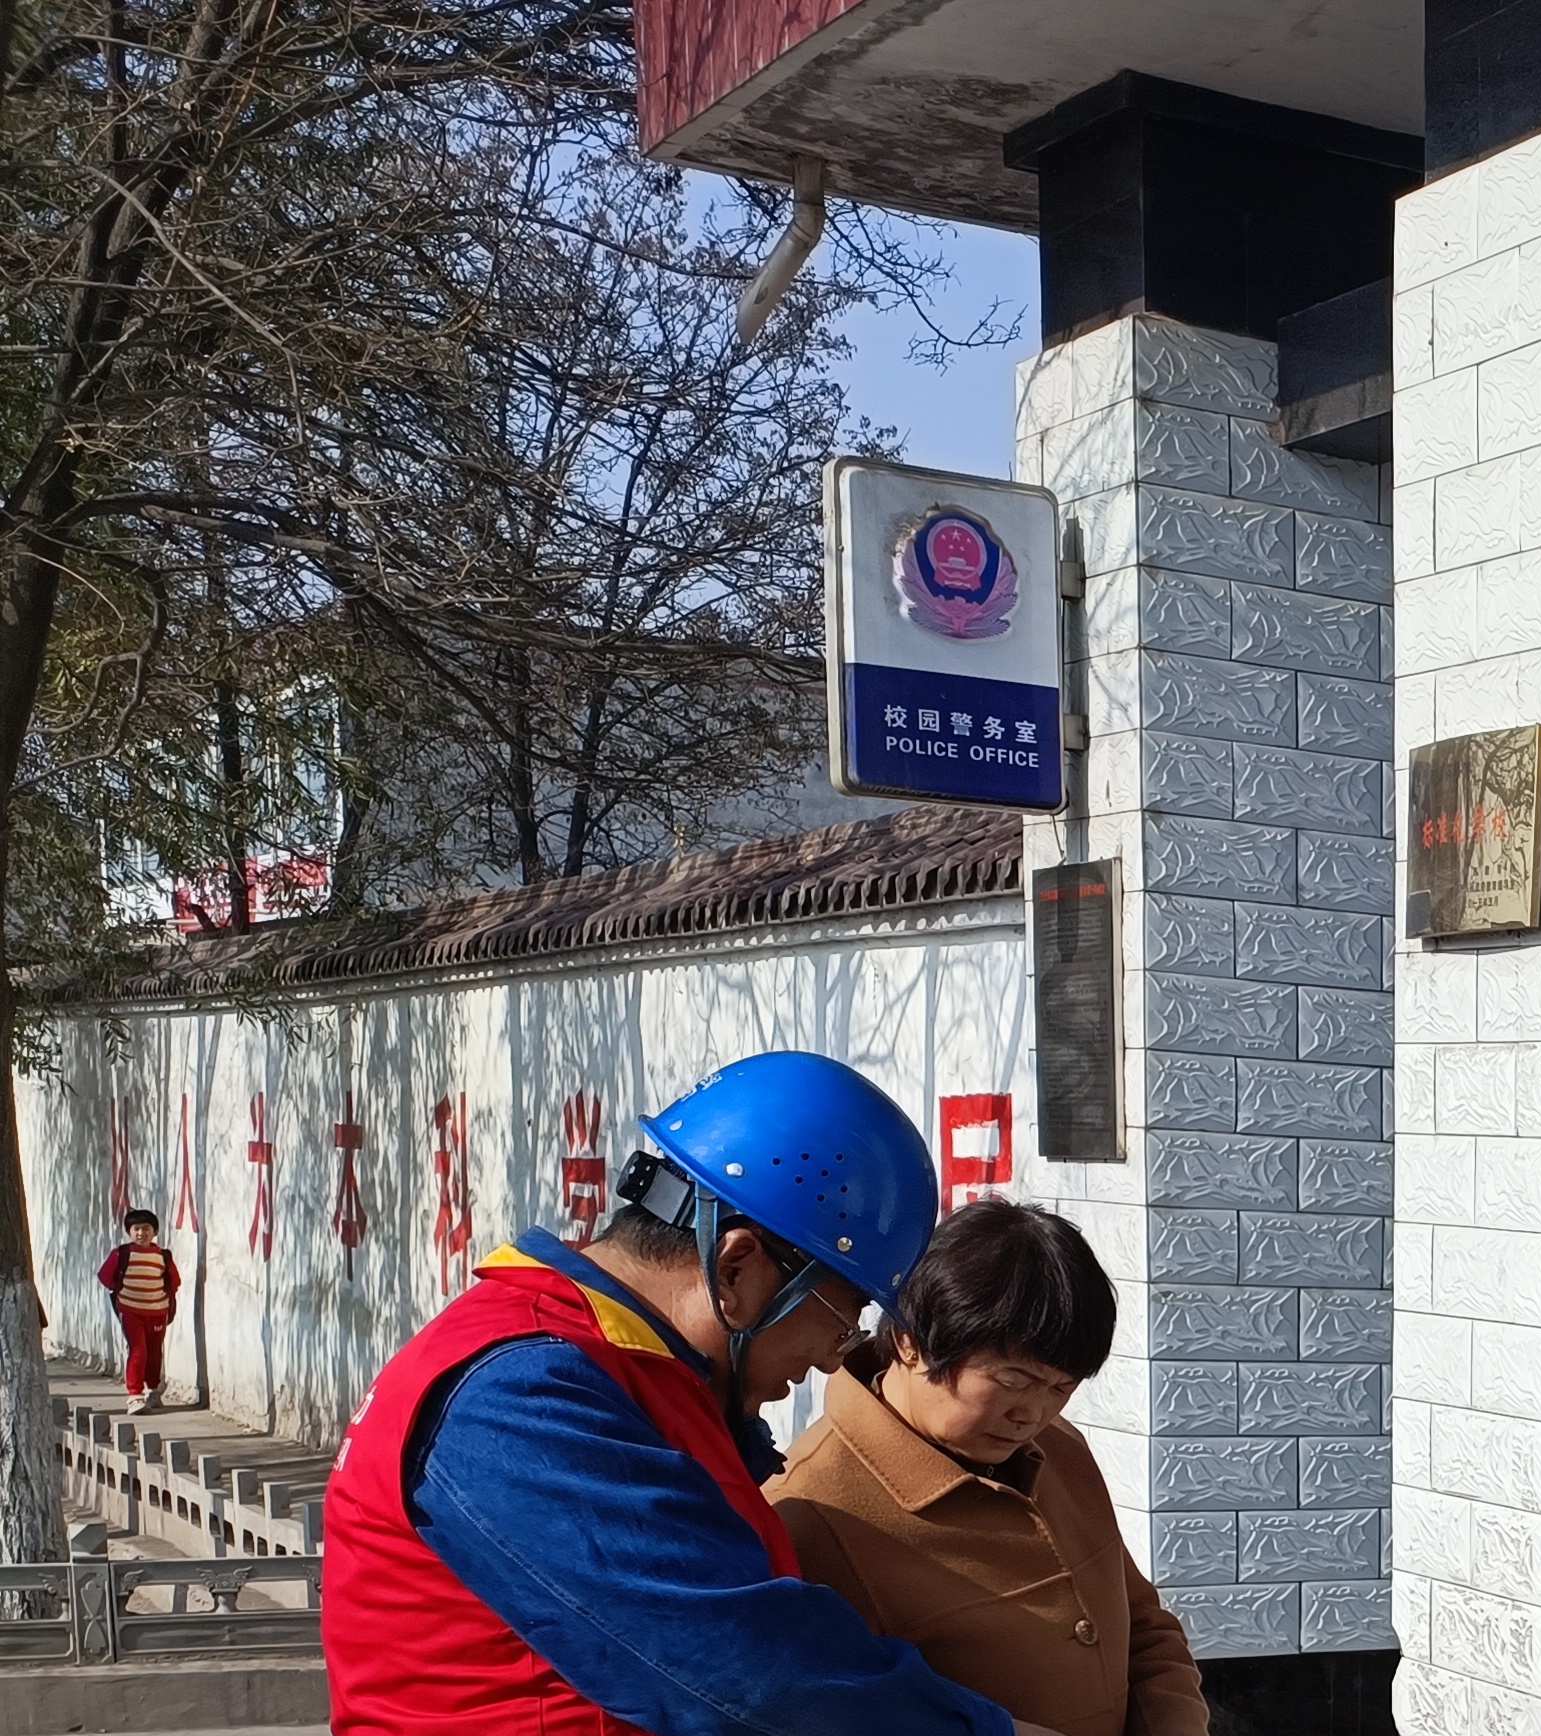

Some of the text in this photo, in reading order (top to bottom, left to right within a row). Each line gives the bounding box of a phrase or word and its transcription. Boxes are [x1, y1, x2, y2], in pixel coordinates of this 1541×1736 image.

[883, 703, 1038, 744] 校园警务室
[885, 735, 1040, 768] POLICE OFFICE
